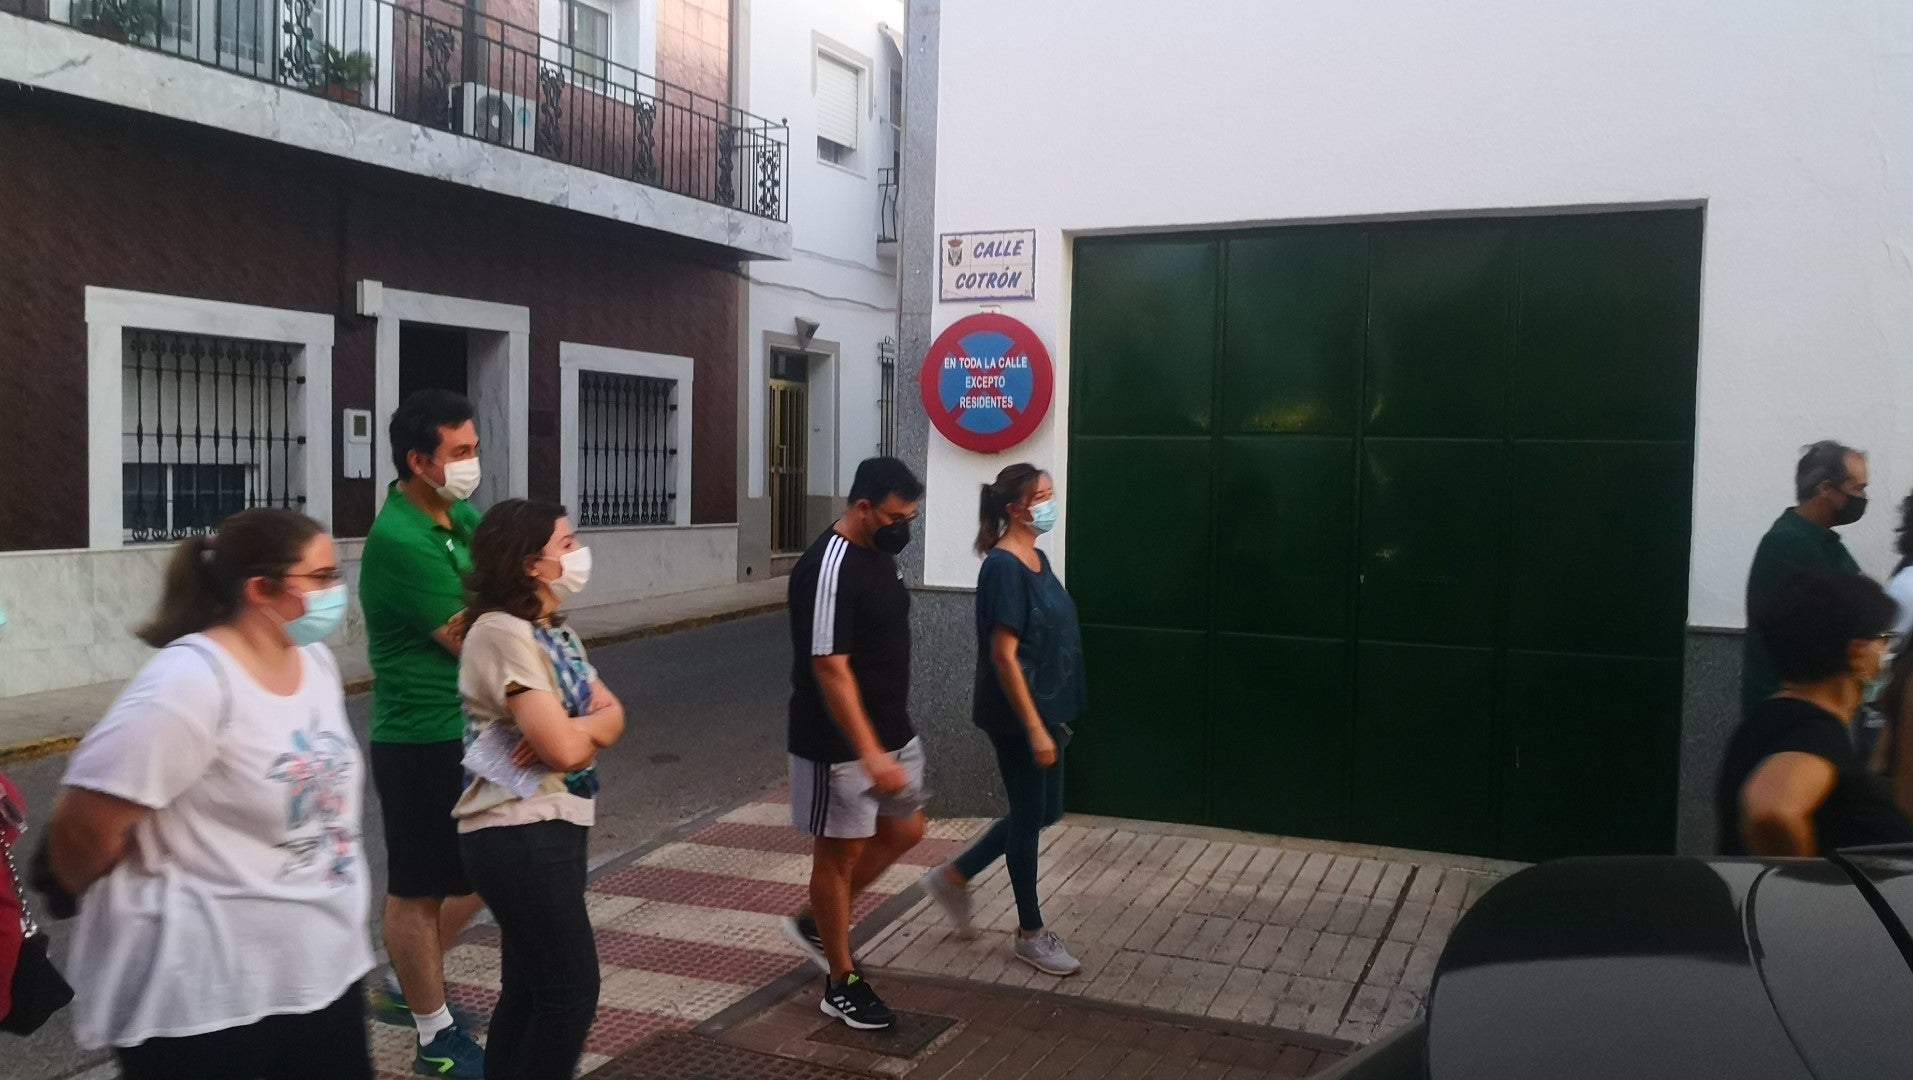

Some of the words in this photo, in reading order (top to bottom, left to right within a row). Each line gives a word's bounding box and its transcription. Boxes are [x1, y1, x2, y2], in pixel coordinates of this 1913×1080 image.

[973, 240, 1024, 258] CALLE
[955, 266, 1022, 289] COTRÓN
[944, 357, 956, 369] EN
[959, 357, 982, 369] TODA
[984, 357, 996, 369] LA
[998, 356, 1028, 368] CALLE
[965, 376, 1006, 388] EXCEPTO
[960, 396, 1013, 409] RESIDENTES
